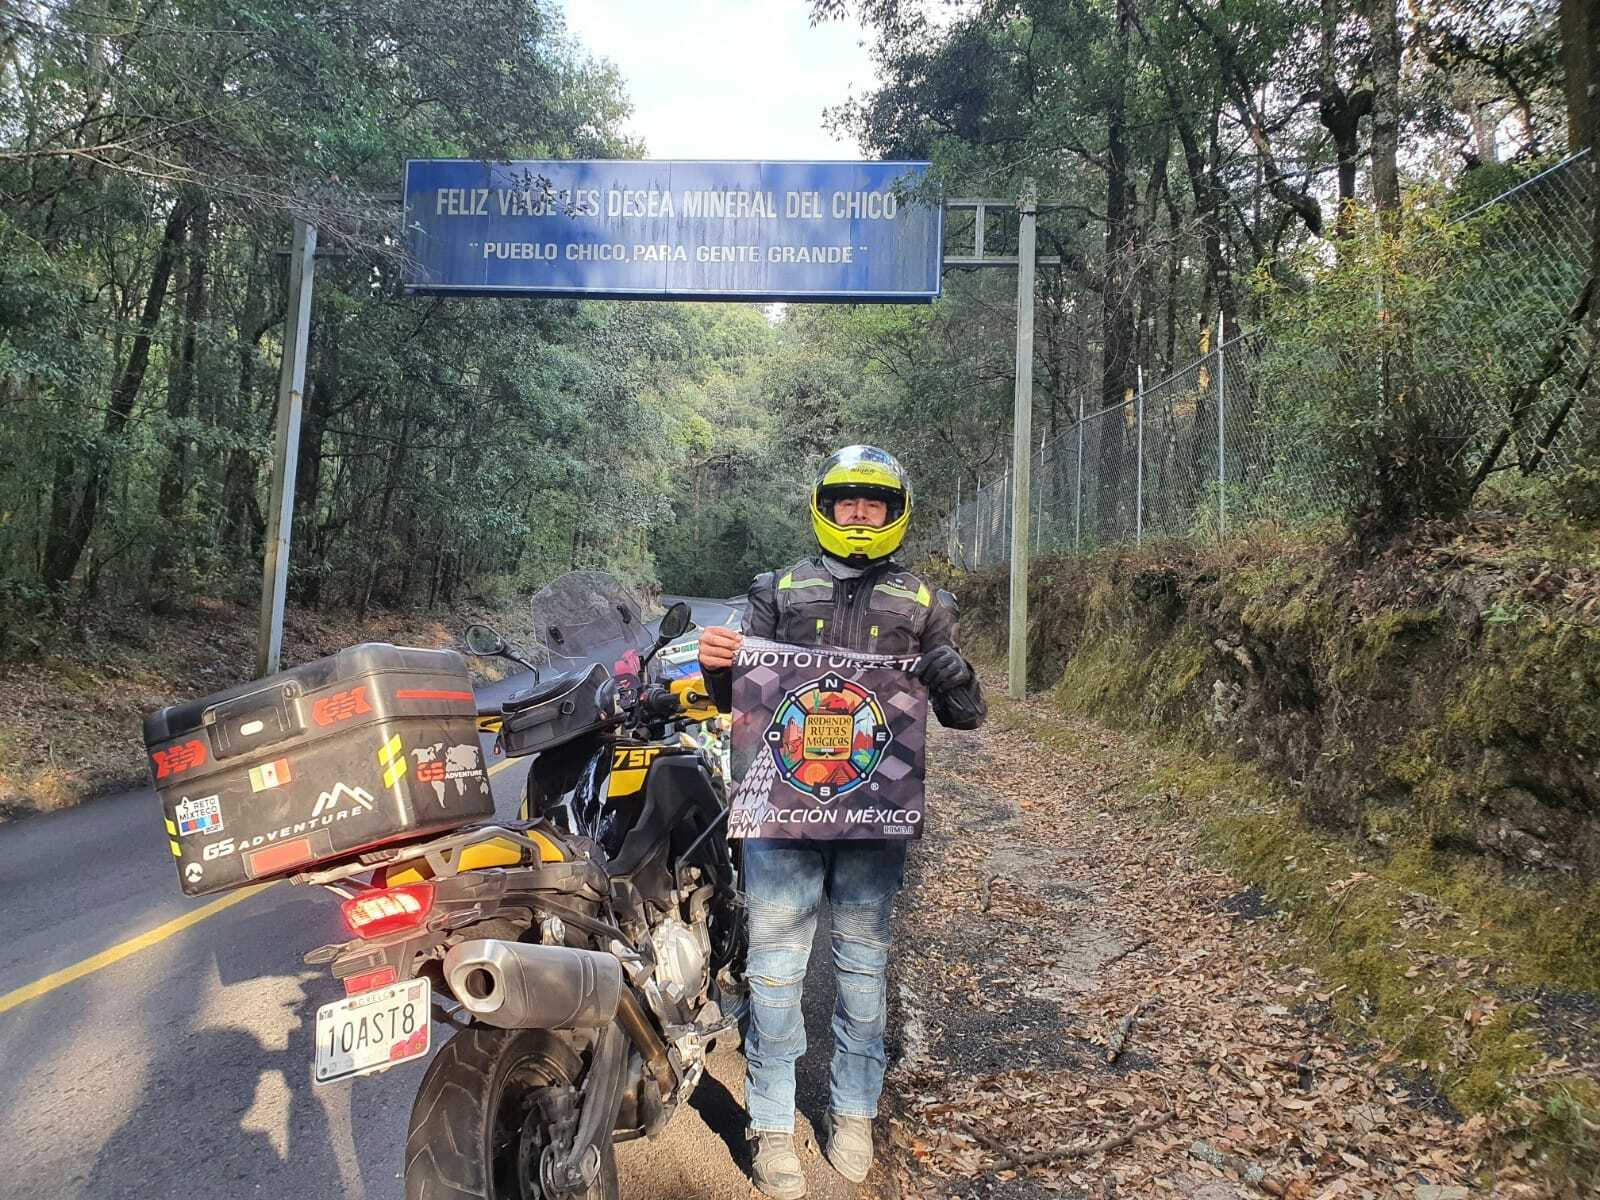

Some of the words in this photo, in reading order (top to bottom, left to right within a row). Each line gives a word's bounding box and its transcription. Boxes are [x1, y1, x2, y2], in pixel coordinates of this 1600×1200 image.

[436, 188, 489, 216] FELIZ
[608, 189, 675, 218] DESEA
[683, 190, 777, 220] MINERAL
[786, 191, 824, 220] DEL
[832, 191, 897, 221] CHICO
[696, 245, 761, 263] GENTE
[825, 679, 838, 688] N
[876, 732, 886, 741] E
[416, 761, 445, 782] GS
[445, 769, 483, 779] ADVENTURE
[819, 786, 831, 797] S
[193, 797, 217, 810] RETO
[179, 806, 217, 821] MIXTECO
[730, 808, 756, 824] EN
[763, 806, 838, 824] ACCIÓN
[845, 806, 921, 824] MÉXICO
[204, 838, 235, 860] GS
[238, 805, 363, 851] ADVENTURE
[328, 1002, 415, 1057] 10AST8
